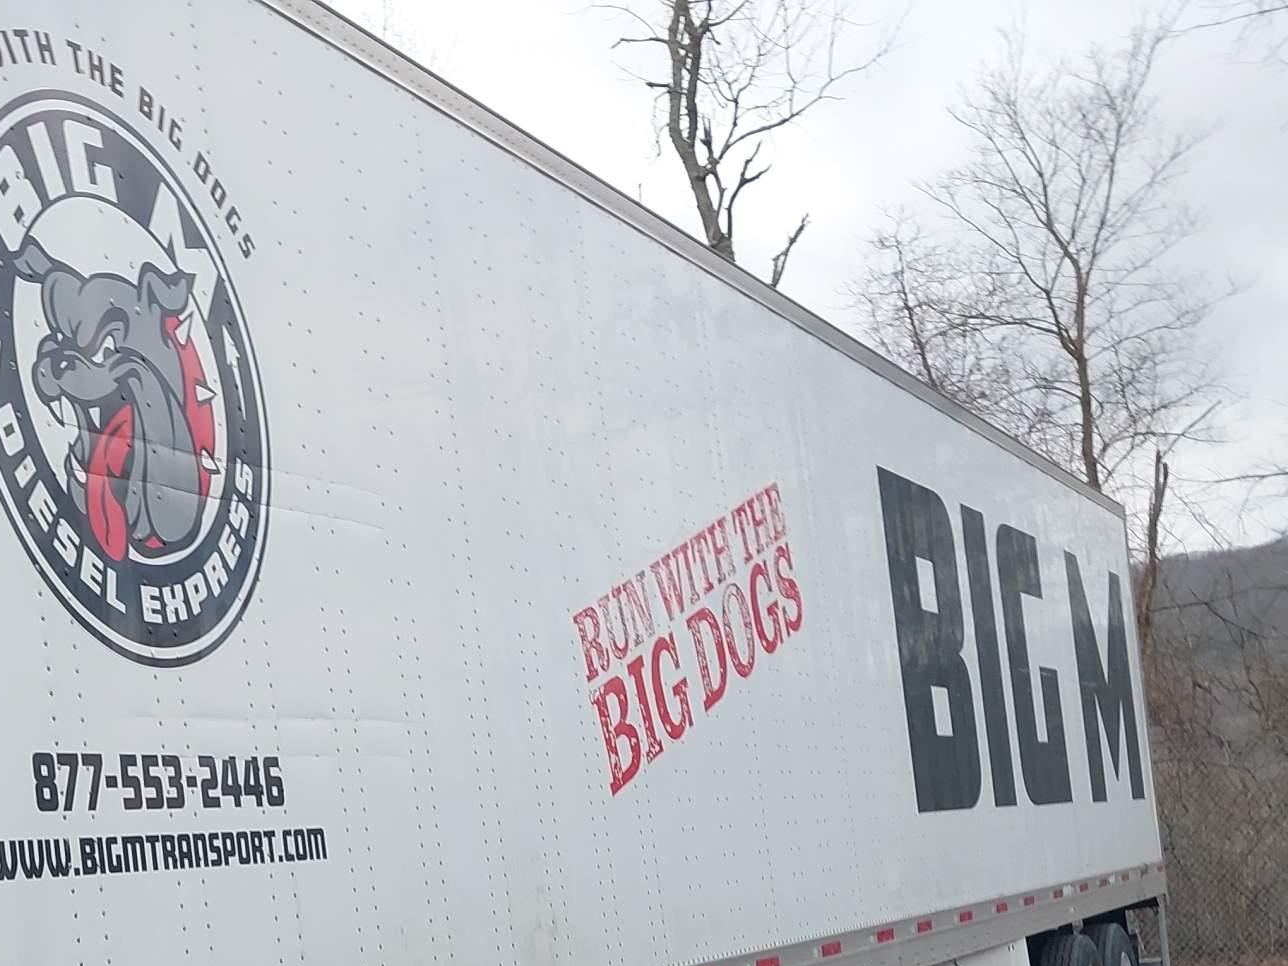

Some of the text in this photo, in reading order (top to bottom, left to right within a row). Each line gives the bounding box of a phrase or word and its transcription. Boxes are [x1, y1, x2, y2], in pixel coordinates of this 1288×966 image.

[65, 38, 125, 98] THE
[139, 86, 183, 152] BIG
[192, 150, 257, 260] DOGS
[148, 182, 226, 321] M
[140, 459, 255, 626] EXPRESS
[572, 482, 787, 684] RUN WITH THE
[877, 465, 1146, 814] BIG M
[588, 542, 804, 797] BIG DOGS
[32, 752, 285, 812] 877-553-2446
